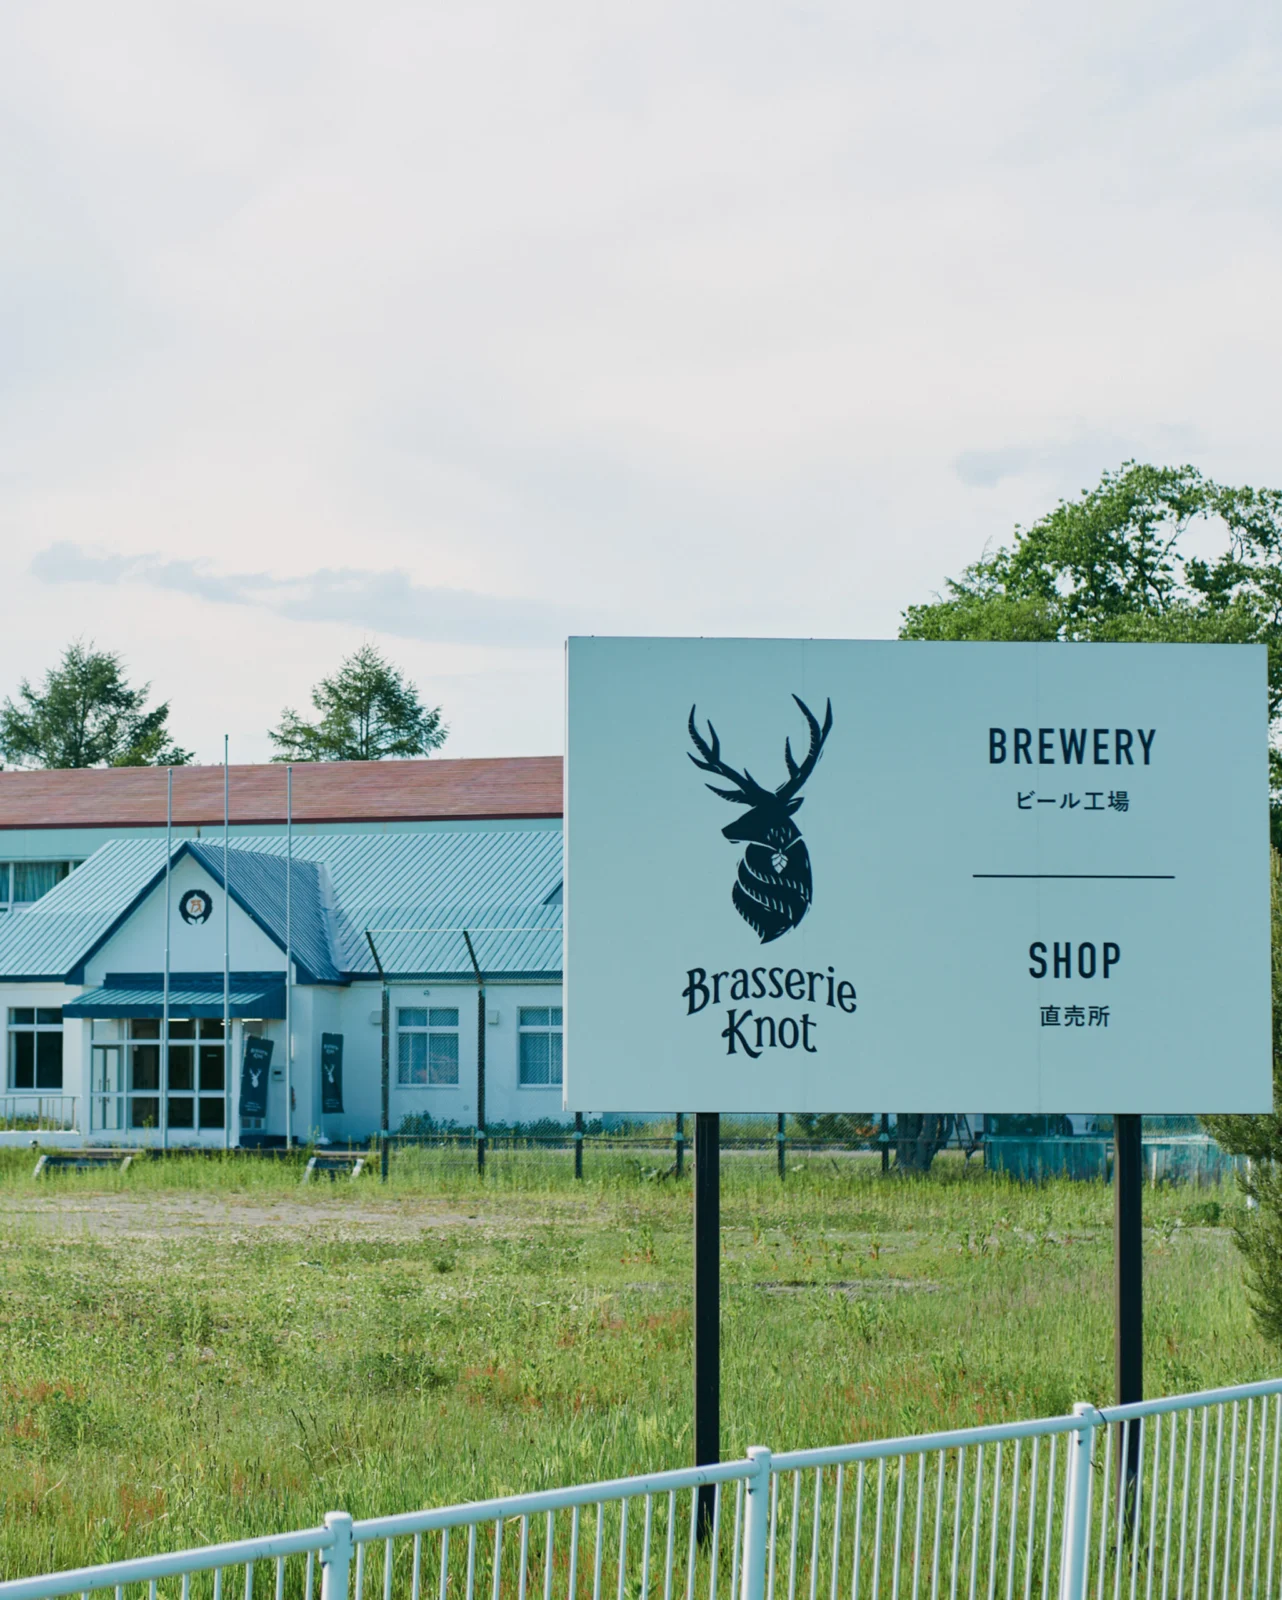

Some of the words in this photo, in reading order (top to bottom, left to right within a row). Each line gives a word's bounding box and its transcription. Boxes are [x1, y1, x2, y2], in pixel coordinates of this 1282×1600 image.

[989, 727, 1156, 766] BREWERY
[1016, 790, 1130, 813] ビール工場
[1028, 941, 1121, 979] SHOP
[681, 965, 857, 1016] Brasserie
[721, 1008, 818, 1059] Knot
[1039, 1004, 1110, 1028] 直売所
